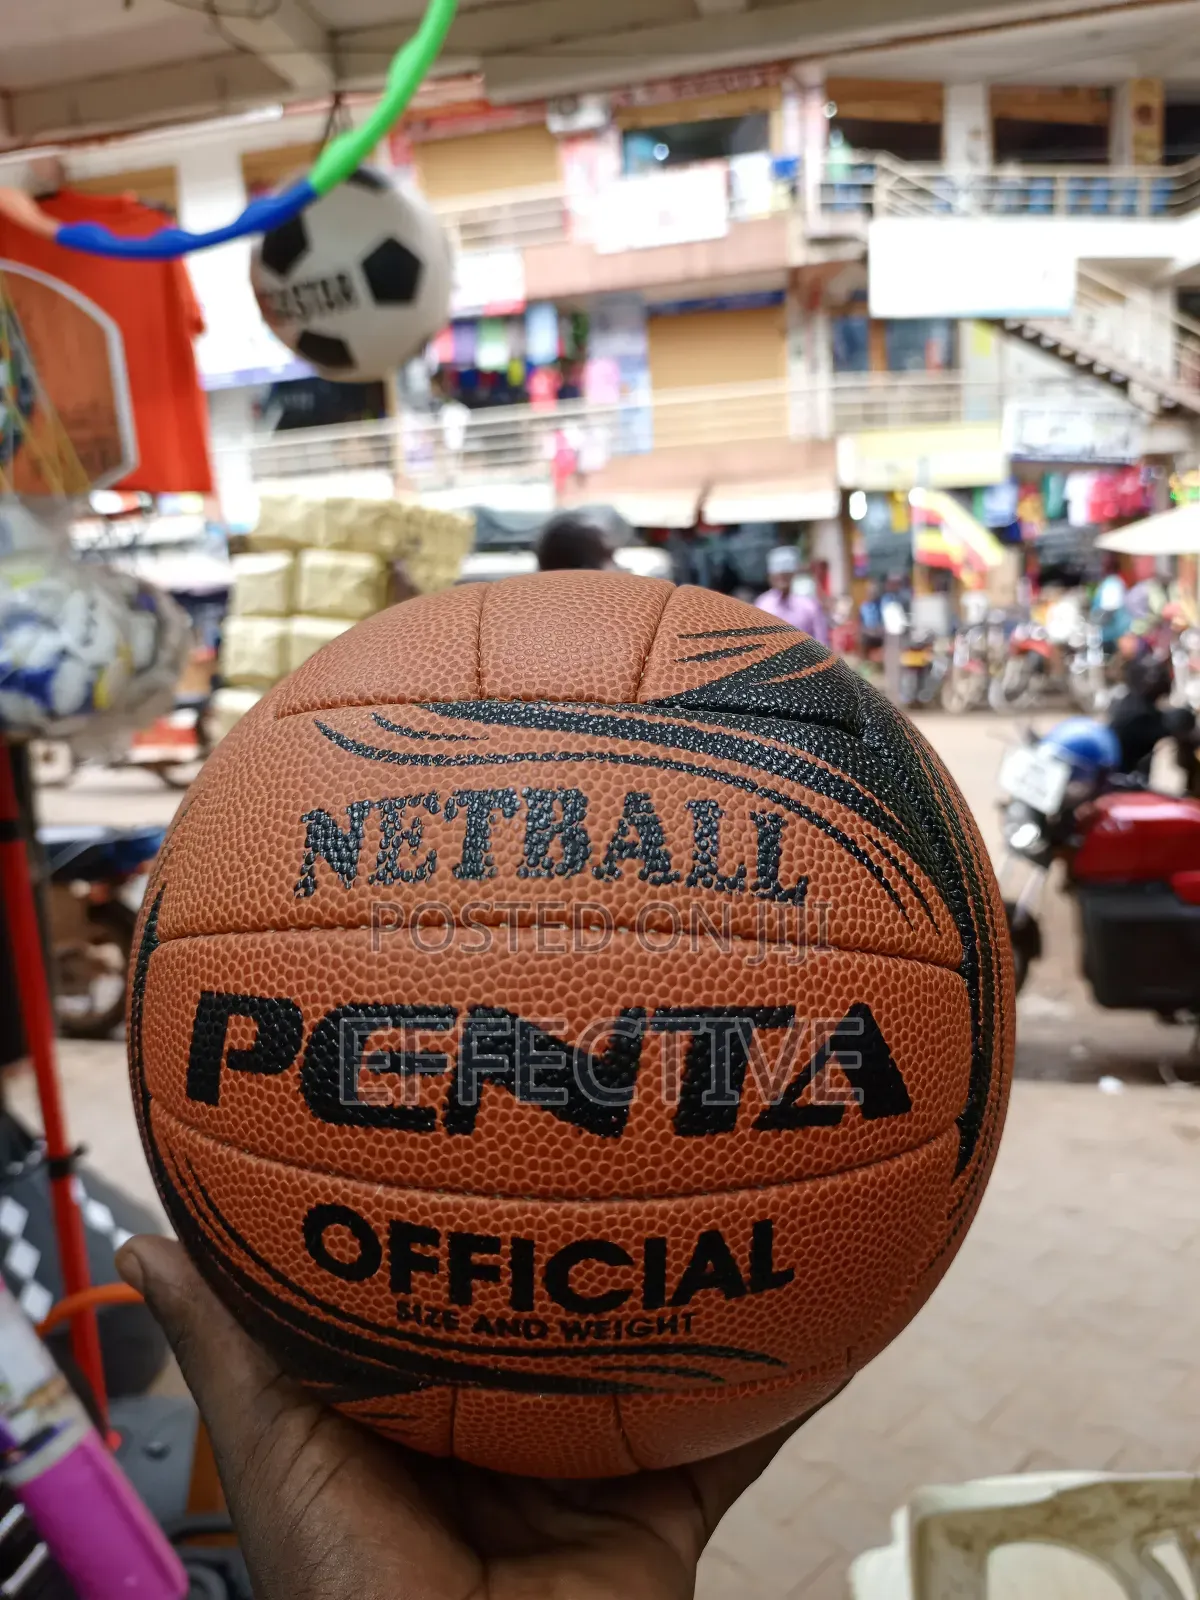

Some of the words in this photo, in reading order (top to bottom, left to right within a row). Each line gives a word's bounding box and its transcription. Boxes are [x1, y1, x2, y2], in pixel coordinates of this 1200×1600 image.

[293, 787, 808, 906] NETBALL
[186, 990, 911, 1138] PENTA
[302, 1203, 795, 1313] OFFICIAL
[398, 1302, 462, 1331] SIZE
[472, 1315, 549, 1342] AND
[559, 1311, 697, 1343] WEIGHT
